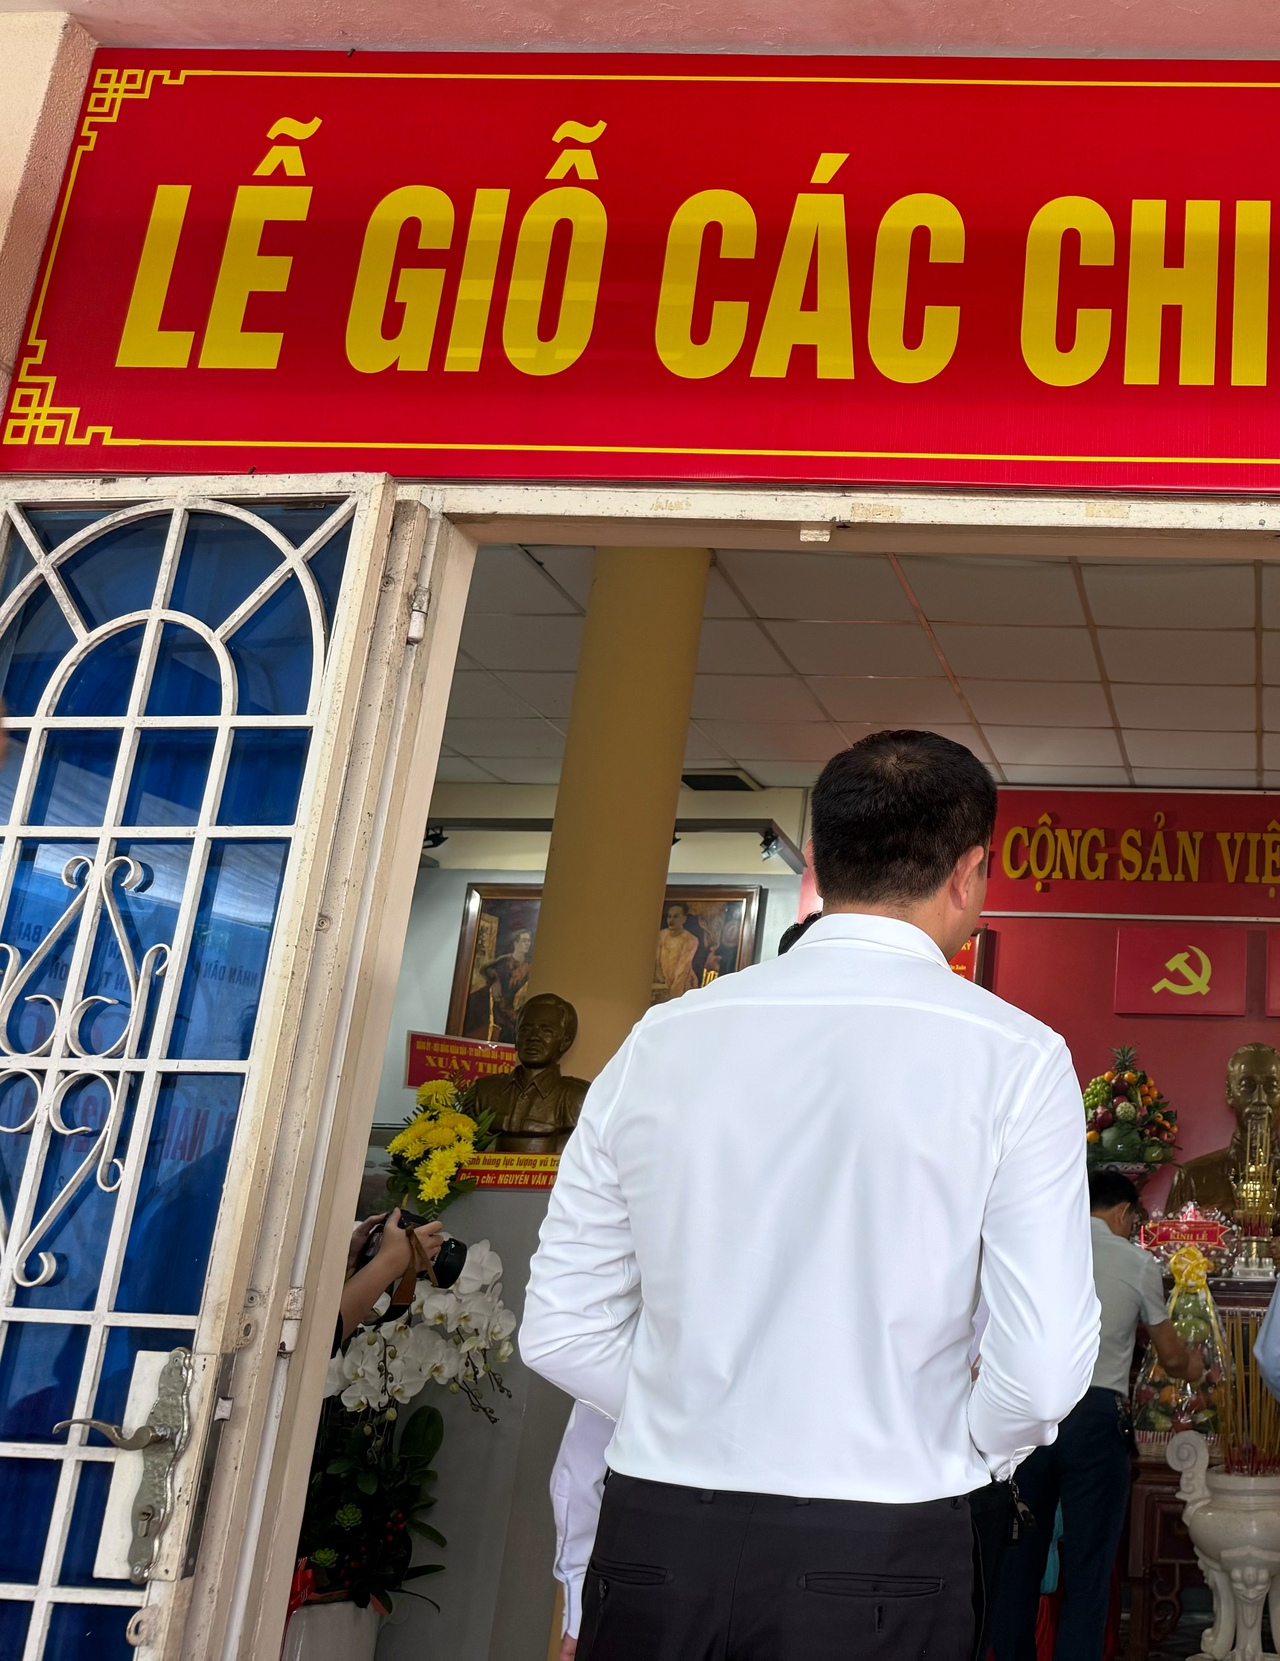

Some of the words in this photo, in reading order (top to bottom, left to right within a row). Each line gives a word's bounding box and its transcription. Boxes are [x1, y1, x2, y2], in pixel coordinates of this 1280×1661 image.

[116, 117, 322, 369] LỄ
[345, 120, 608, 376] GIỖ
[655, 153, 965, 383] CÁC
[1002, 813, 1108, 892] CỘNG
[1119, 812, 1204, 883] SẢN
[425, 1055, 471, 1071] XUÂN
